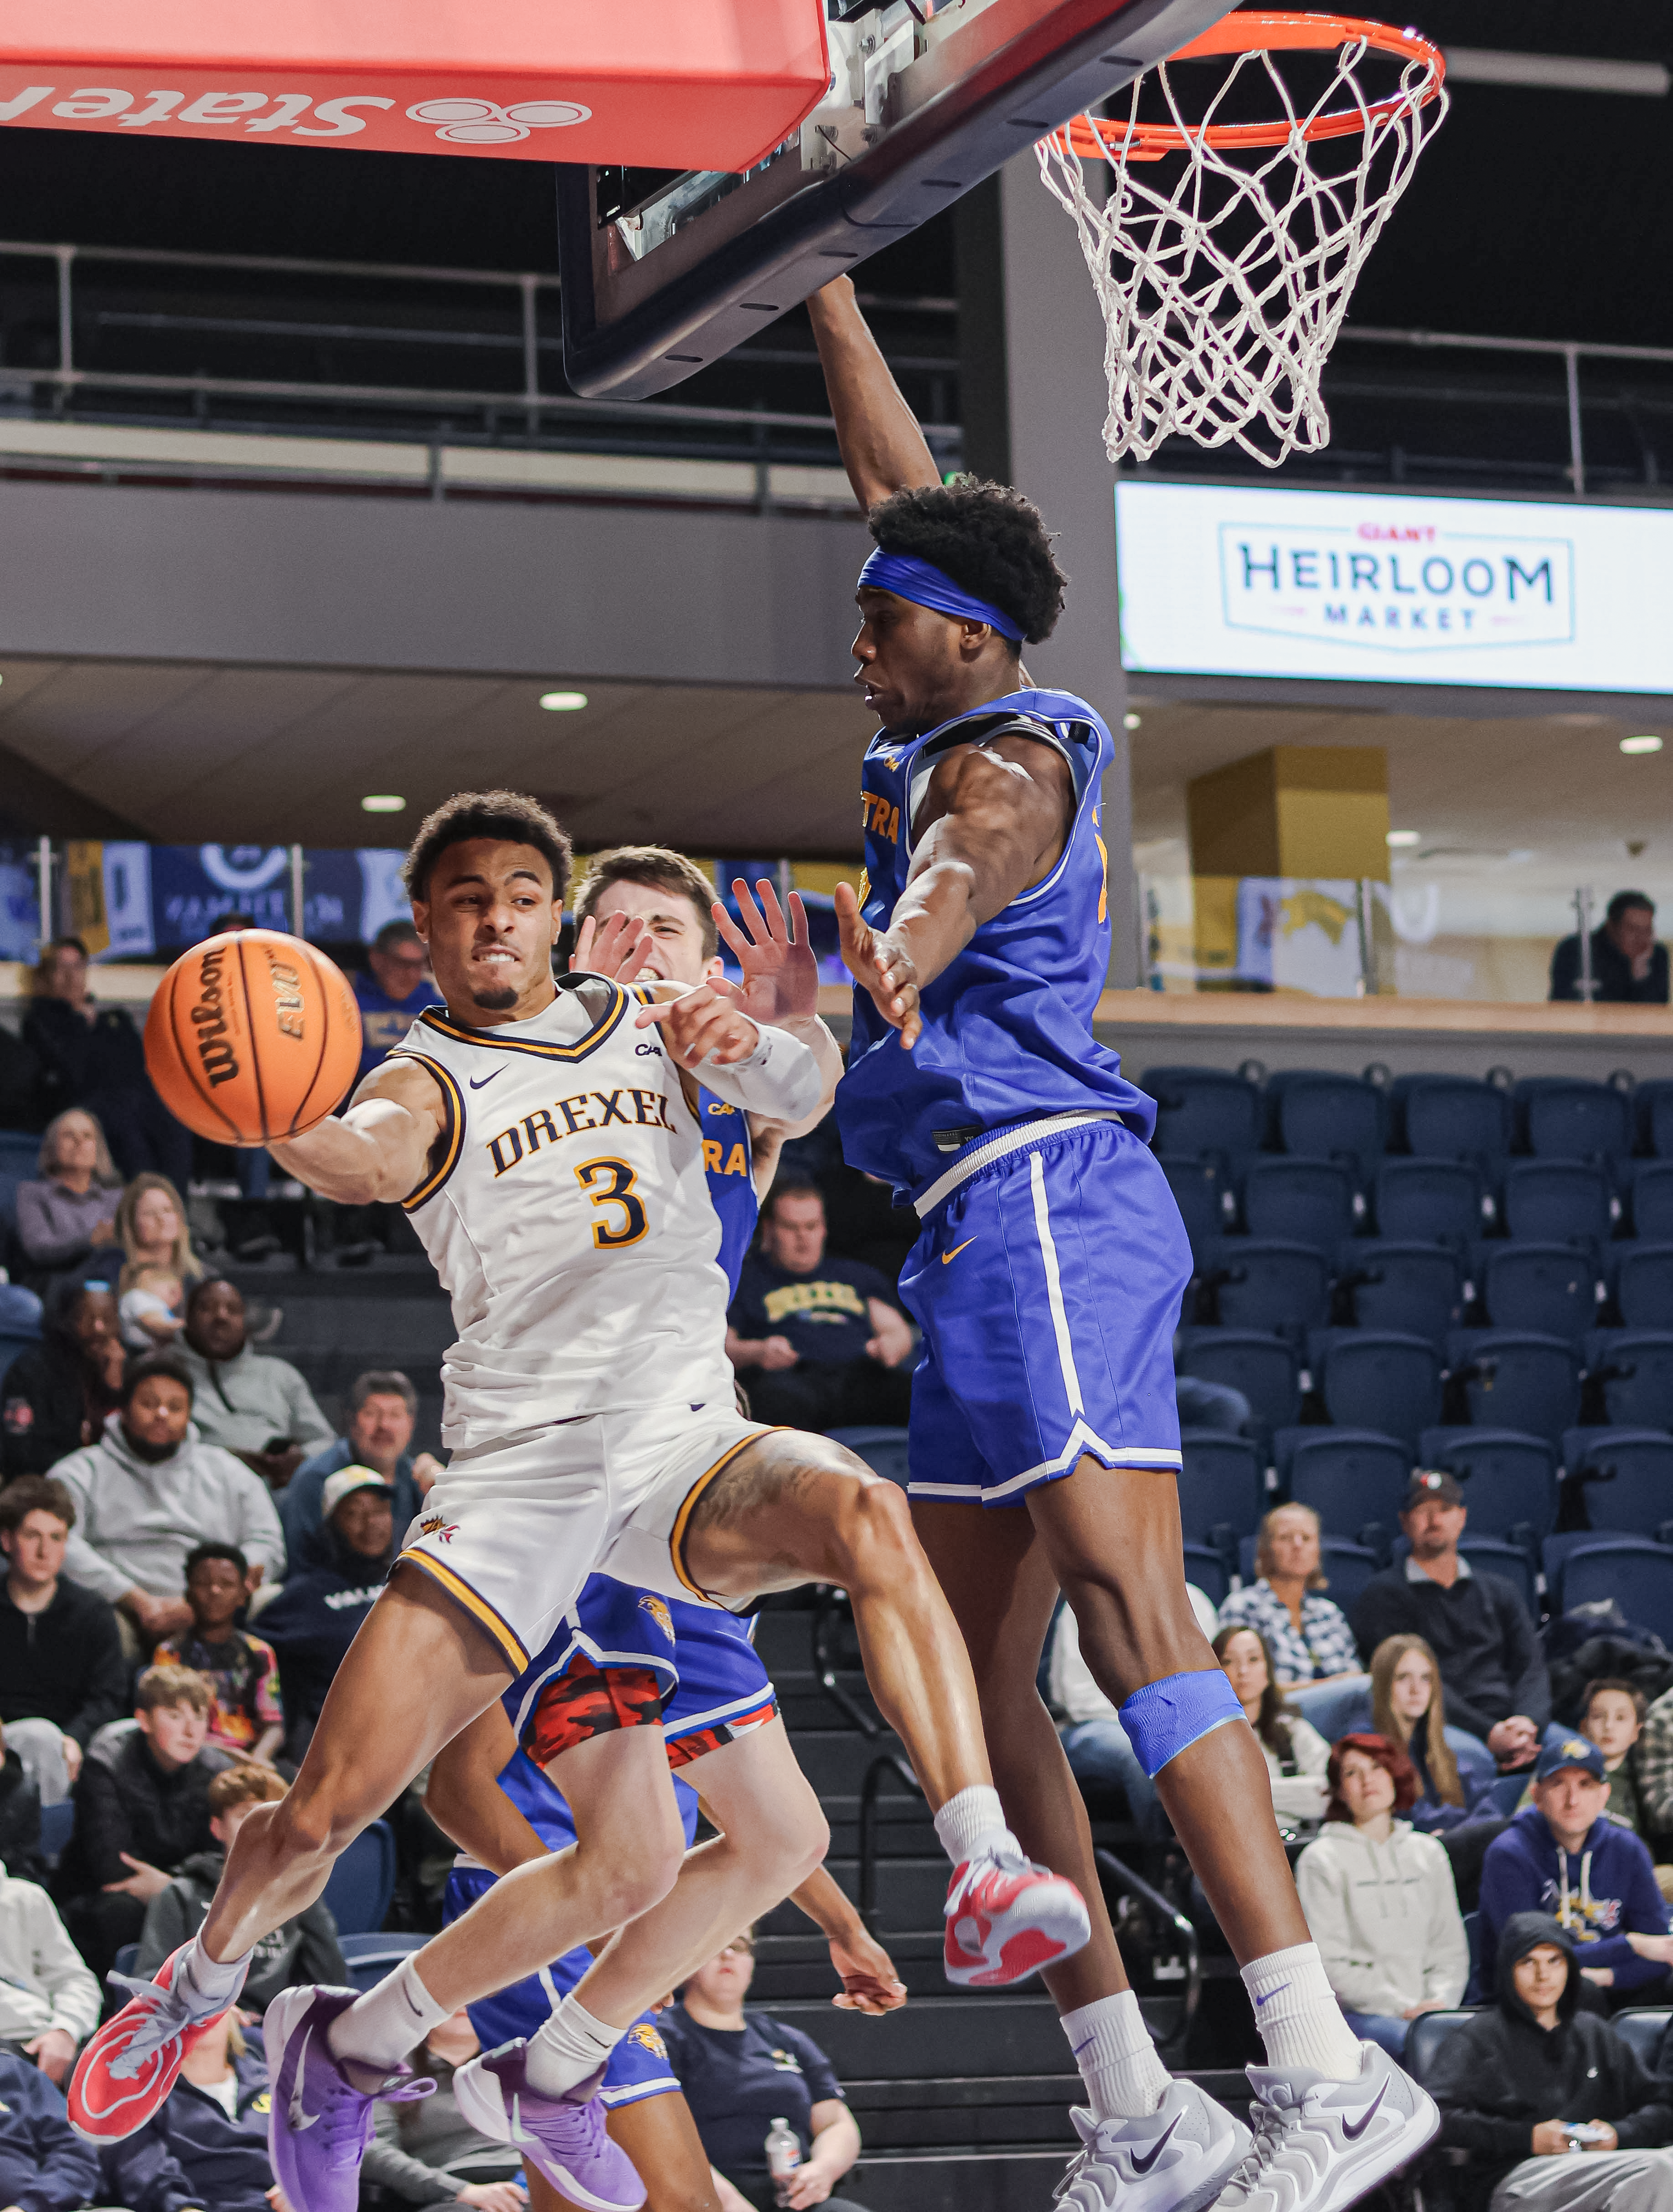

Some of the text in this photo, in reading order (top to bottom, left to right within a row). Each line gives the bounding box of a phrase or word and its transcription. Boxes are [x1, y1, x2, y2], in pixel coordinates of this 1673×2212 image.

[1357, 523, 1436, 542] GIANT
[1238, 542, 1554, 603] HEIRLOOM
[1324, 603, 1476, 630] MARKET
[191, 947, 240, 1088] Wilson
[486, 1088, 677, 1178] DREXEL
[573, 1156, 650, 1249] 3
